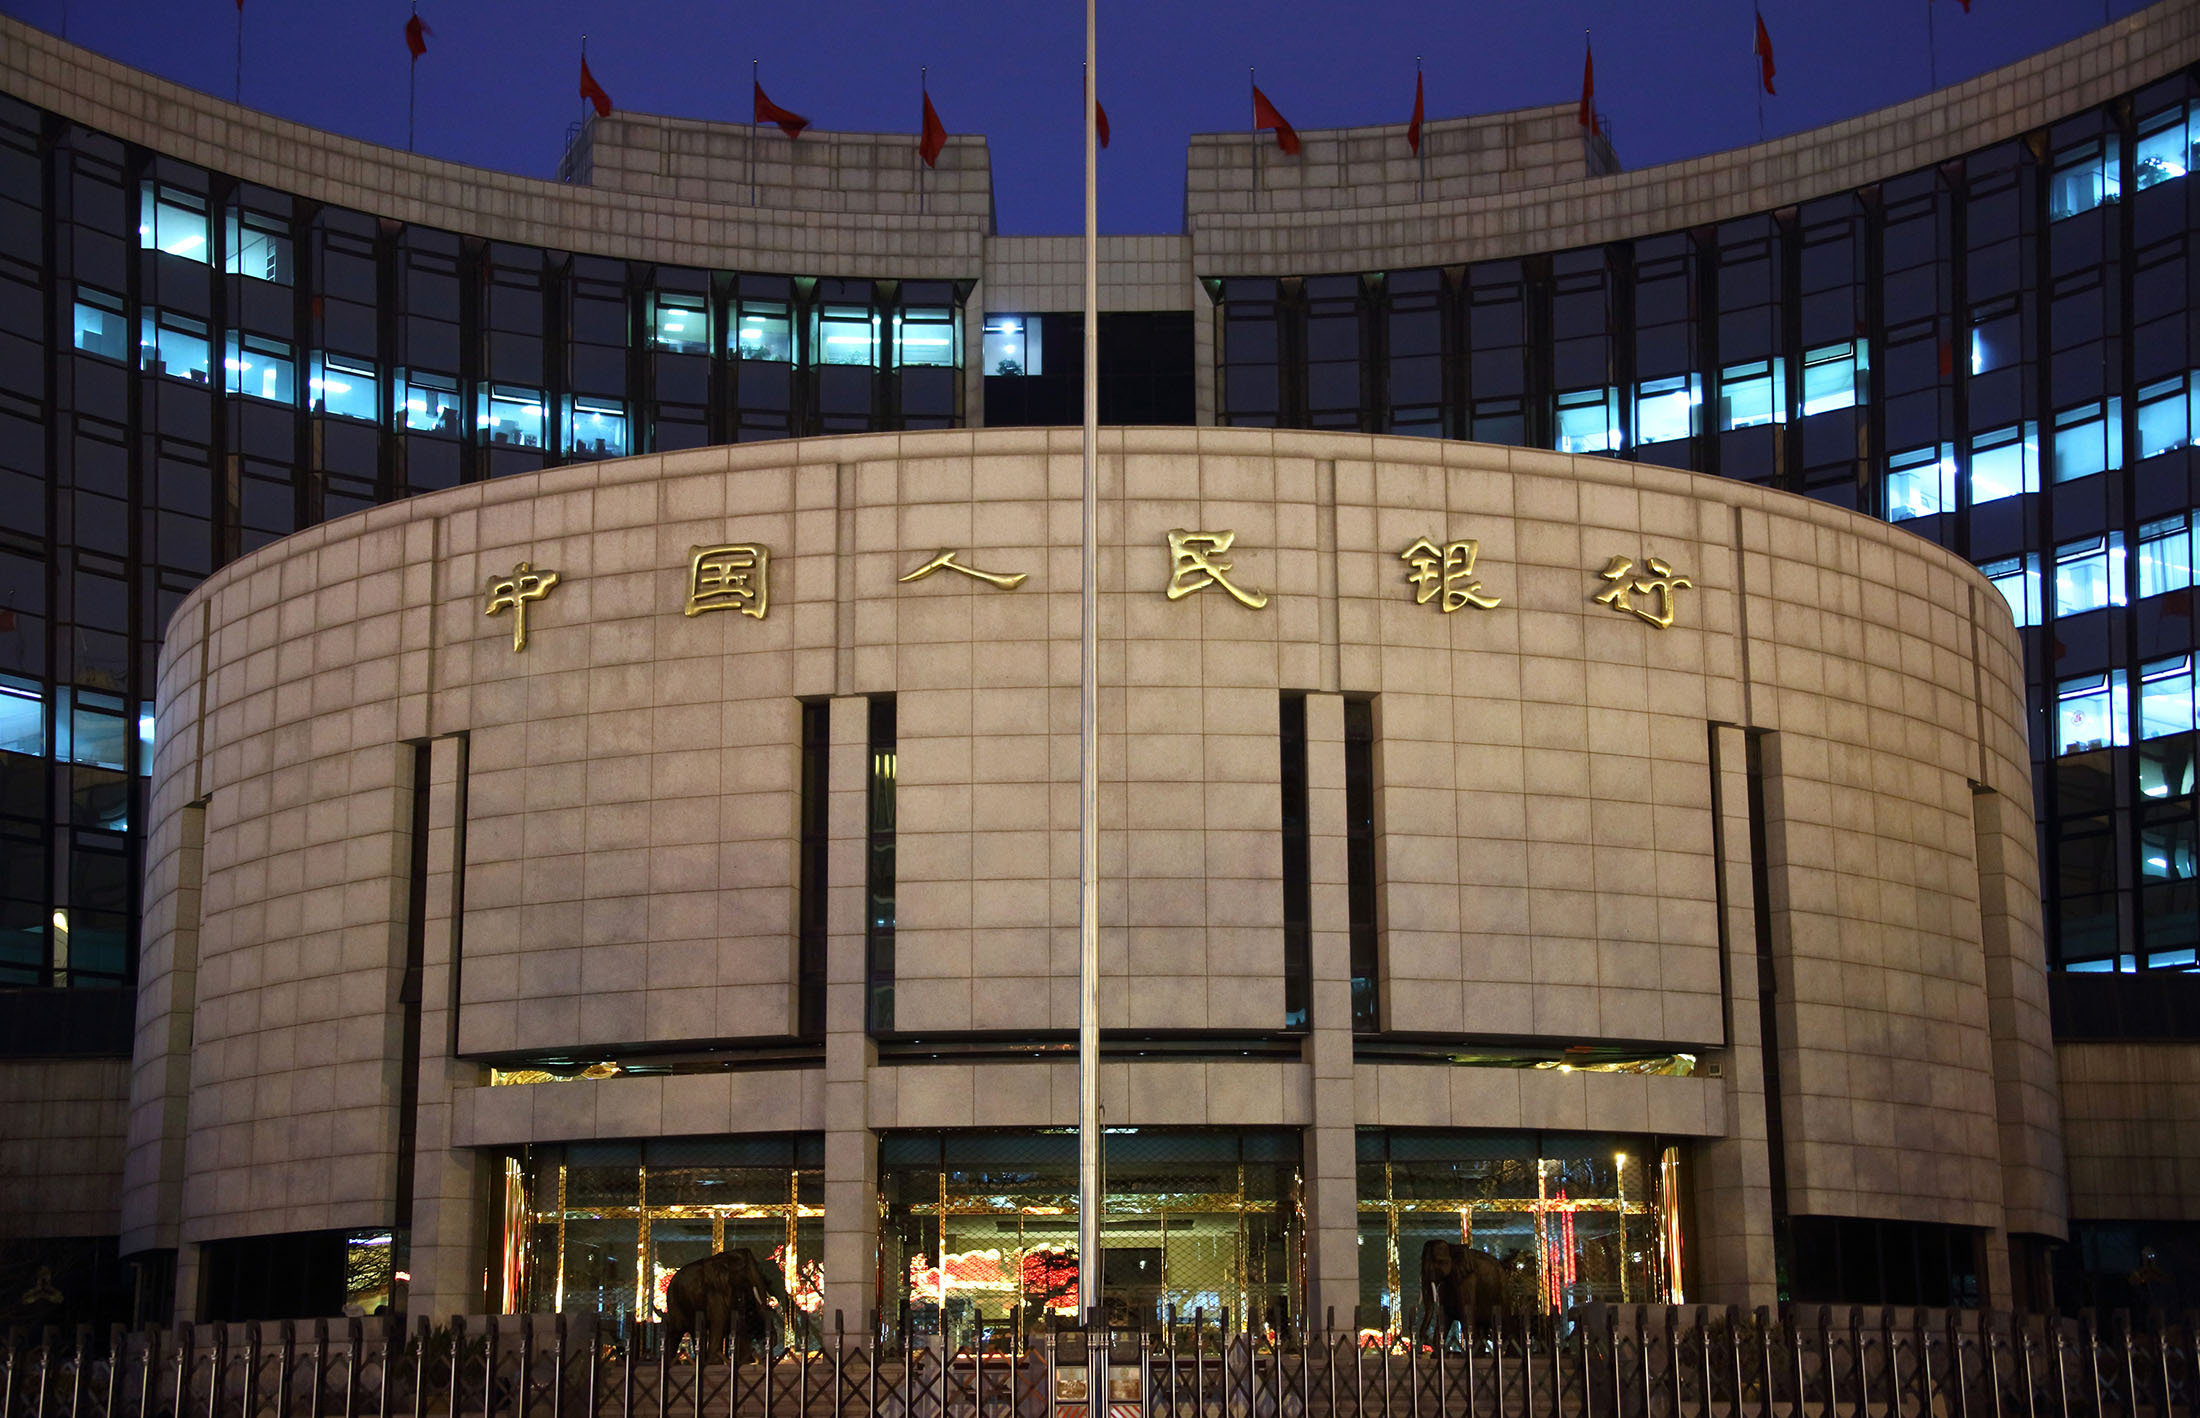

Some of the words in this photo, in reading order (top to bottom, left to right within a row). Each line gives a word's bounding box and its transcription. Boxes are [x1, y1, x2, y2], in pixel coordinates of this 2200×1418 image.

[484, 528, 1692, 652] 中国人民银行
